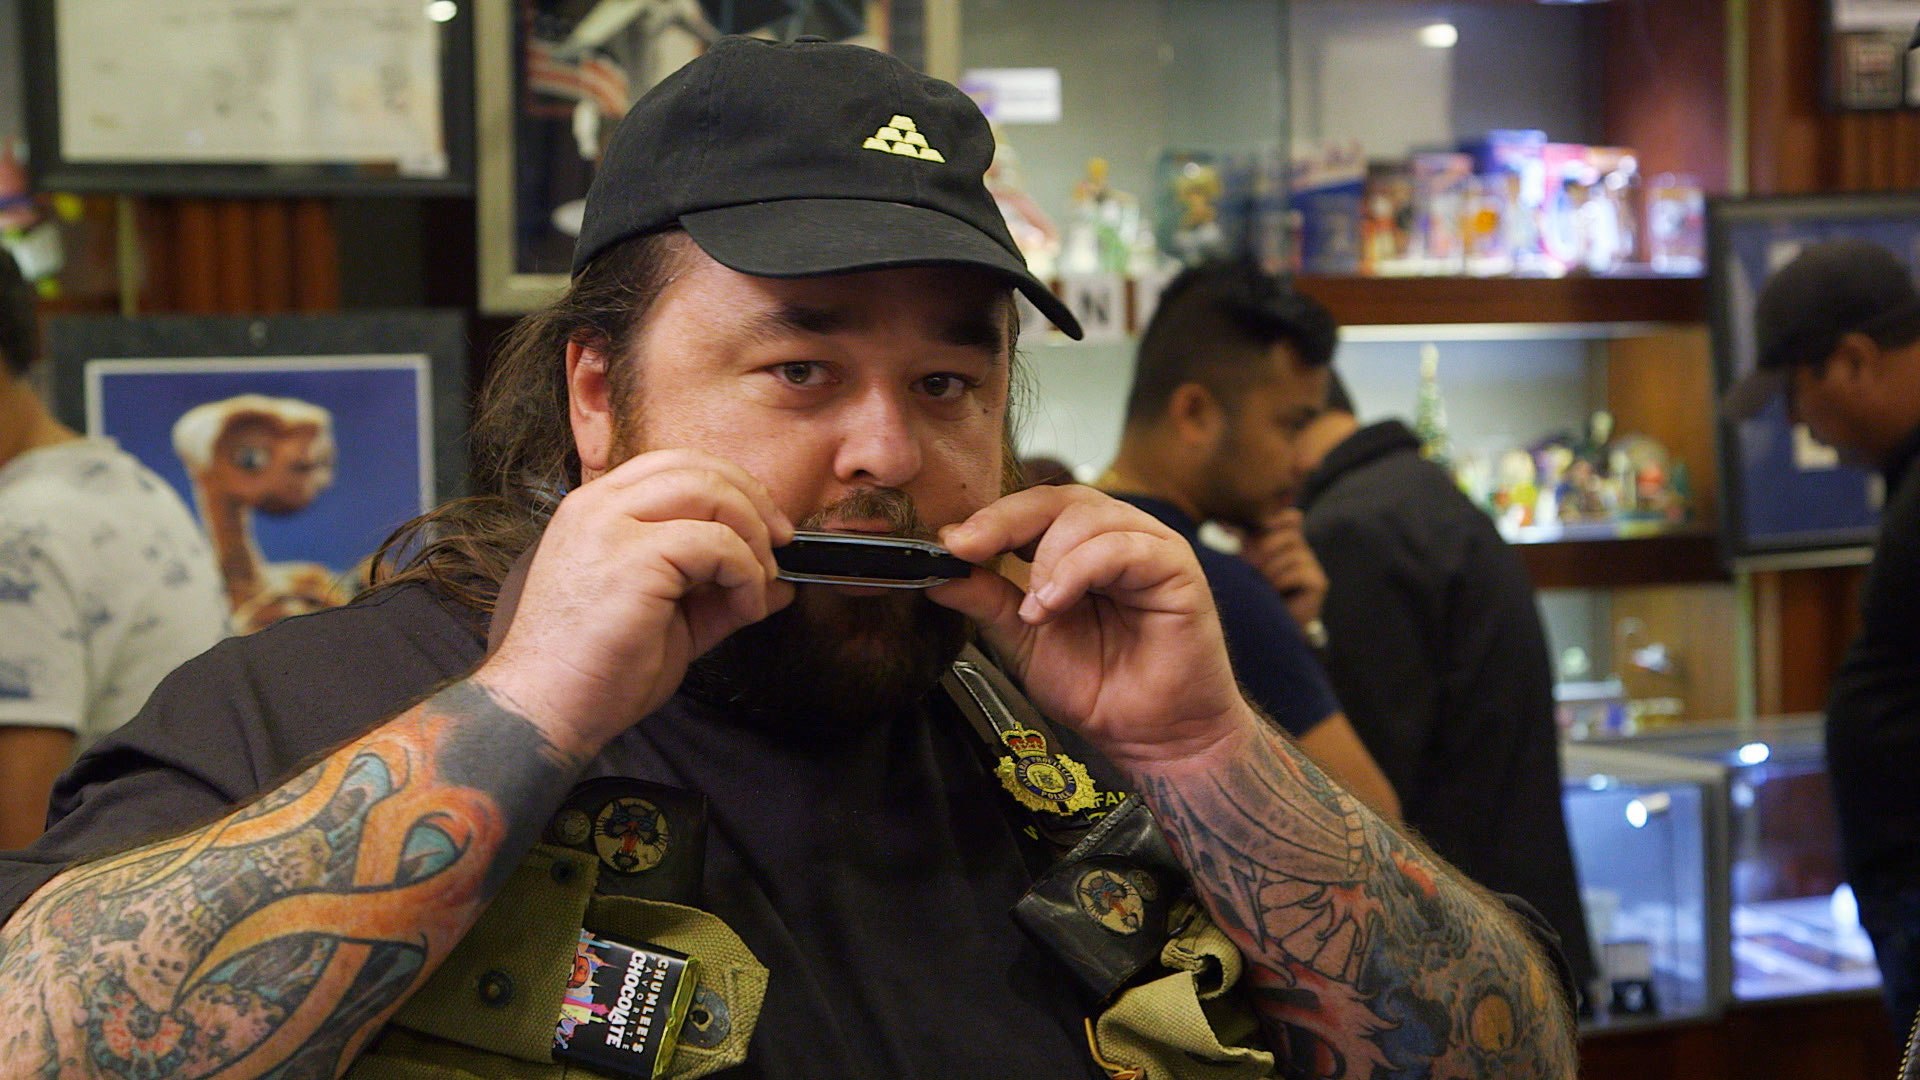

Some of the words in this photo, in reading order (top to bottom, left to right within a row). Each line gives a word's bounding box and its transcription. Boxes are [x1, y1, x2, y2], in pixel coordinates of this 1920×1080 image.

[1041, 790, 1073, 801] POLICE
[605, 950, 647, 1049] CHOCOLATE
[622, 953, 656, 1050] FAVORITE
[632, 958, 670, 1054] CHUMLEE'S
